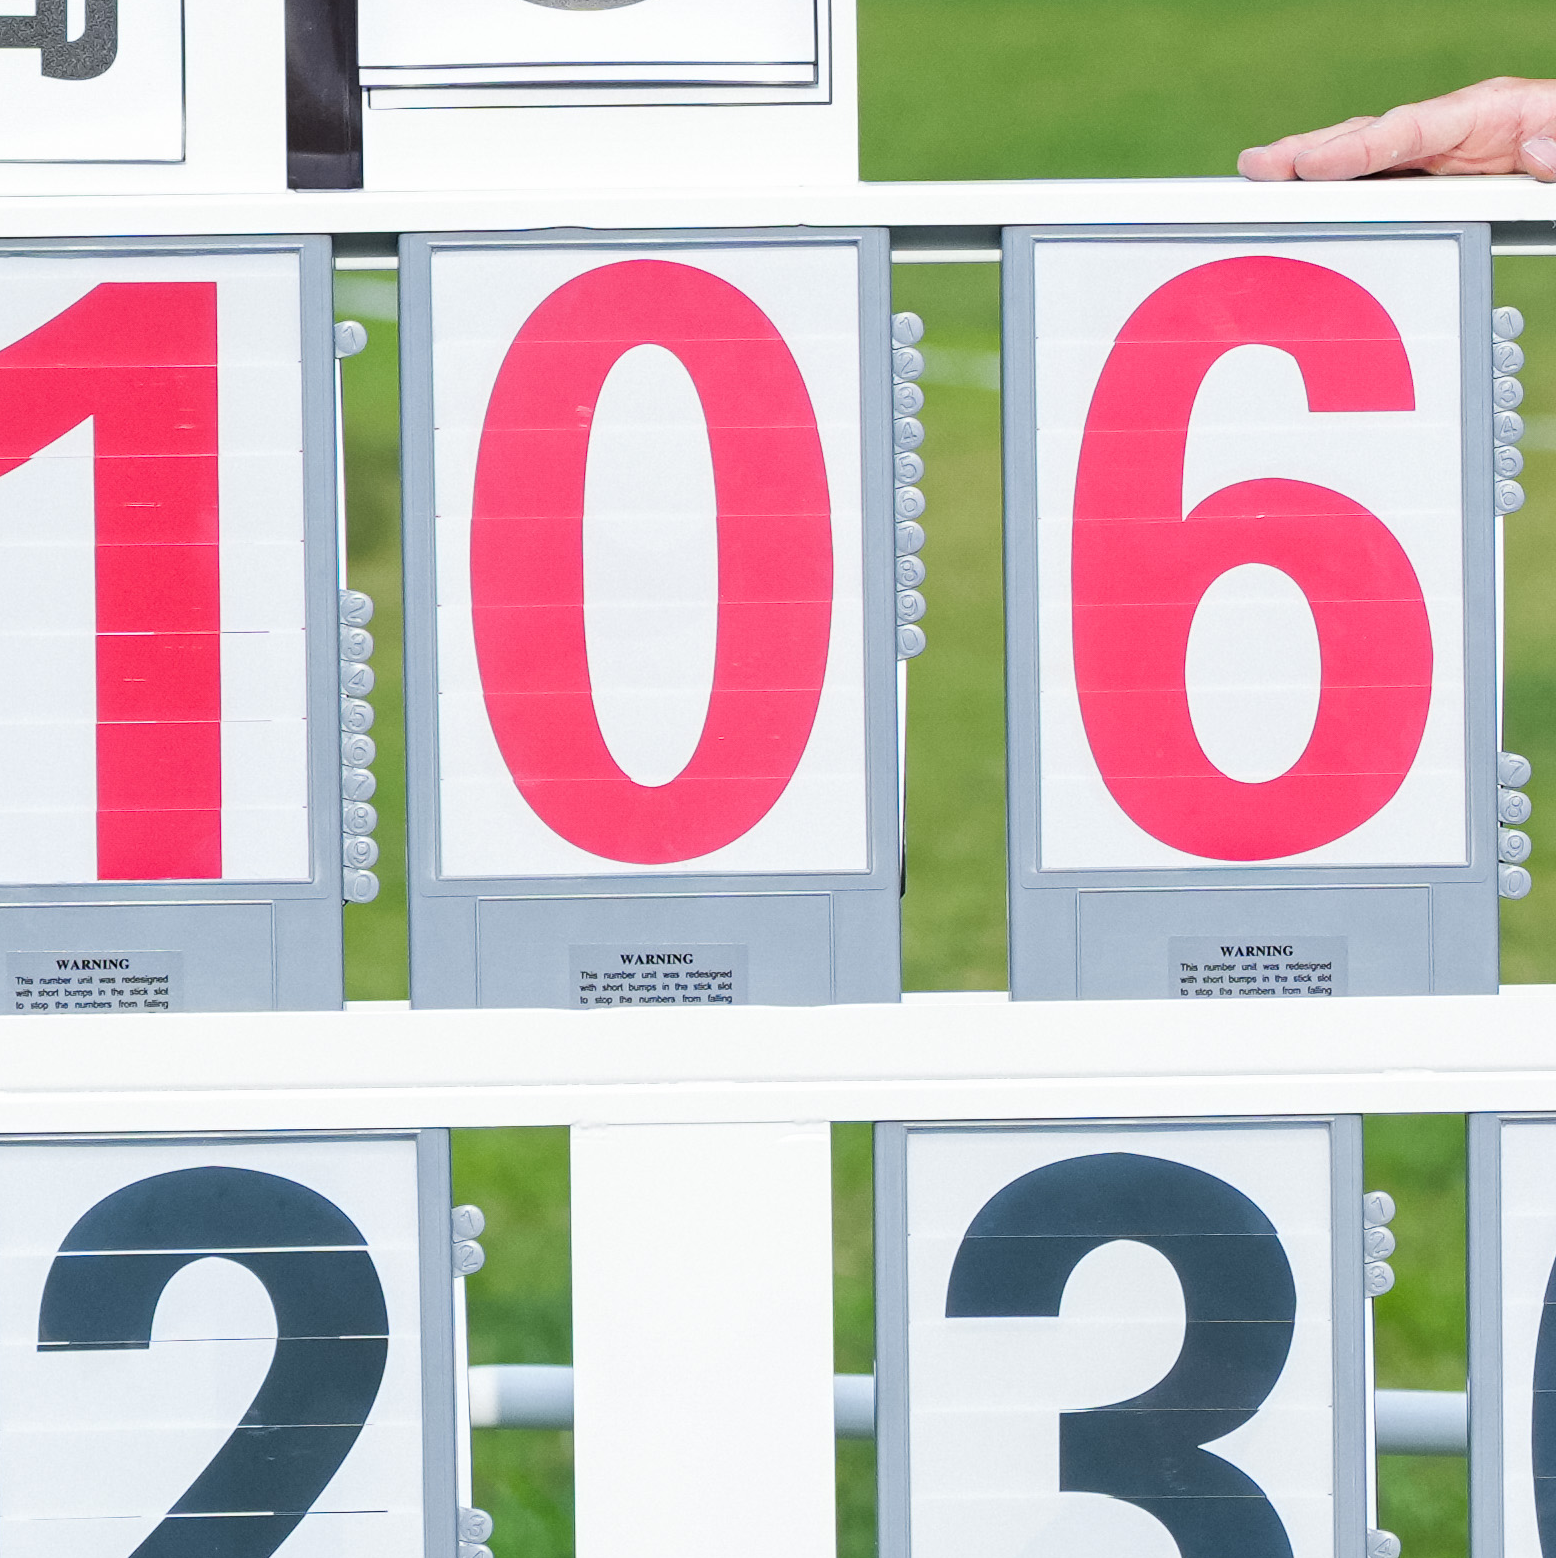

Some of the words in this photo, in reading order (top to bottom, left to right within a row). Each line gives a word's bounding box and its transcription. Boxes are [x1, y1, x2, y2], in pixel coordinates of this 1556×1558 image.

[1220, 945, 1293, 957] WARNING
[56, 958, 129, 971] WARNING
[620, 954, 693, 965] WARNING
[15, 977, 33, 985] This
[39, 976, 72, 985] number
[77, 976, 93, 984] unit
[122, 975, 169, 986] redesigned
[580, 971, 598, 979] This
[604, 970, 636, 980] number
[641, 971, 657, 979] unit
[686, 970, 732, 981] redesigned
[15, 989, 32, 997] with
[38, 988, 59, 997] short
[64, 988, 93, 998] bumps
[98, 988, 106, 996] in
[111, 988, 124, 996] the
[130, 987, 148, 995] stick
[154, 987, 169, 995] slot
[602, 982, 623, 992] short
[628, 982, 657, 992] bumps
[662, 982, 669, 991] in
[675, 983, 688, 991] the
[693, 982, 712, 990] stick
[718, 982, 732, 990] slot
[31, 1002, 49, 1011] stop
[55, 1001, 68, 1010] the
[75, 1000, 112, 1008] numbers
[119, 999, 138, 1009] from
[144, 999, 169, 1009] falling
[580, 996, 588, 1004] to
[595, 996, 613, 1006] stop
[619, 995, 632, 1004] the
[639, 995, 675, 1003] numbers
[682, 994, 701, 1003] from
[708, 994, 732, 1004] falling
